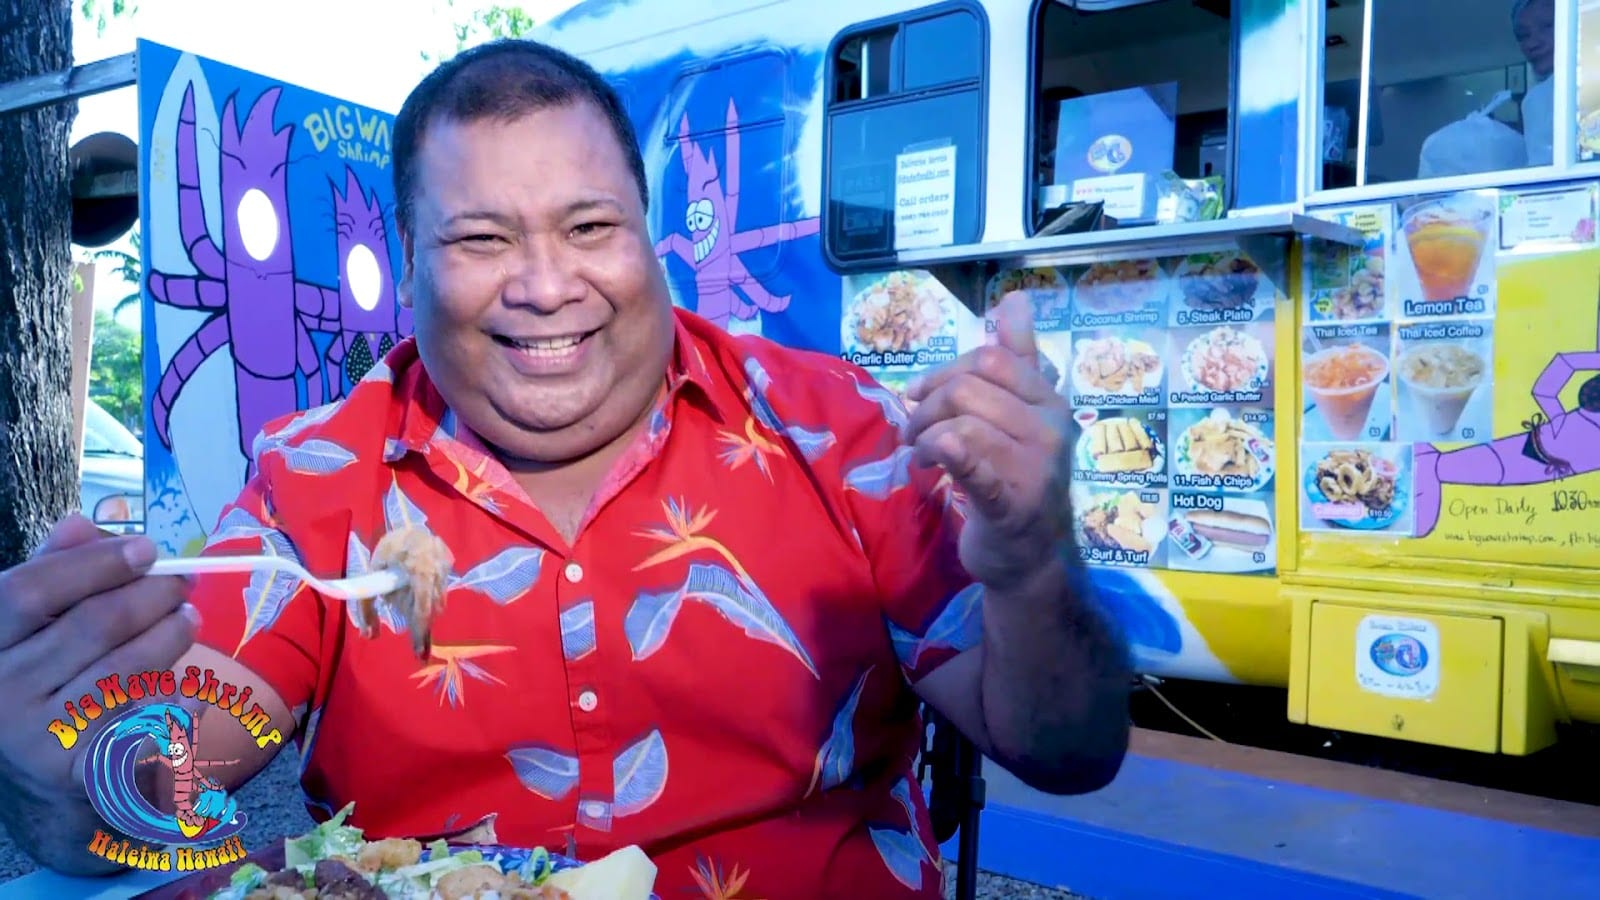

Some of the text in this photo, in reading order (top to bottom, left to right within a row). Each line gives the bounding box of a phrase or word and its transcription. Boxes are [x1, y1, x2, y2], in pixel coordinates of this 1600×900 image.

[303, 104, 391, 153] BIG WA
[899, 193, 949, 207] Call orders
[1405, 298, 1483, 316] Lemon Tea
[1072, 311, 1158, 326] 4. Coconut Shrimp
[1178, 309, 1251, 324] 5. Steak Plate
[1315, 325, 1378, 338] Thai Iced Tea
[1399, 325, 1482, 339] Thai Iced Coffee
[852, 353, 882, 367] Garlic
[883, 352, 915, 365] Butter
[917, 349, 957, 364] Shrimp
[1106, 395, 1138, 404] Chicken
[1210, 392, 1235, 402] Garlic
[1236, 392, 1262, 402] Butter
[1117, 472, 1145, 484] Spring
[1146, 473, 1168, 483] Rolls
[1174, 476, 1253, 489] 11. Fish & Chips
[1173, 495, 1223, 510] Hot Dog
[1448, 498, 1489, 520] Open
[1496, 495, 1537, 525] Daily
[1091, 547, 1113, 560] Surf
[1114, 549, 1123, 560] &
[1125, 550, 1148, 563] Turf
